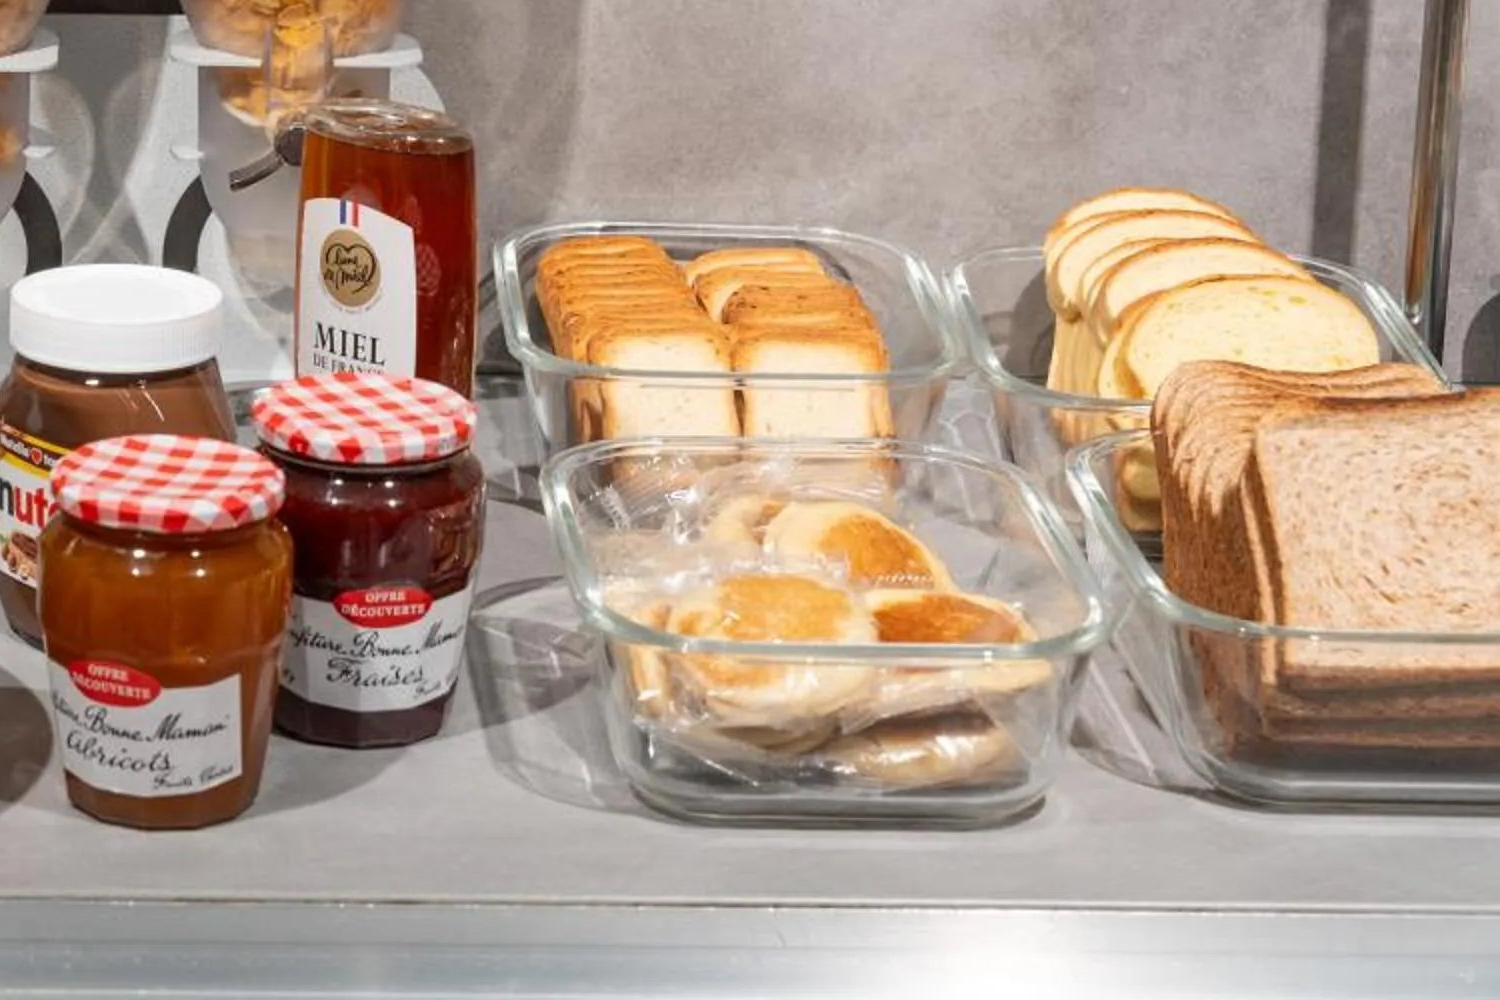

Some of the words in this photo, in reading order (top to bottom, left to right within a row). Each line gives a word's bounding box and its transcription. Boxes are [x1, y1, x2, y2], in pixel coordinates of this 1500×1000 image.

[313, 321, 386, 367] MIEL
[312, 353, 329, 369] DE
[364, 590, 406, 603] OFFRE
[340, 603, 426, 618] DÉCOUVERTE
[350, 631, 412, 658] Bonne
[87, 662, 129, 683] OFFRE
[326, 657, 425, 688] Fraises
[84, 704, 142, 742] Bonne
[146, 712, 228, 742] Maman
